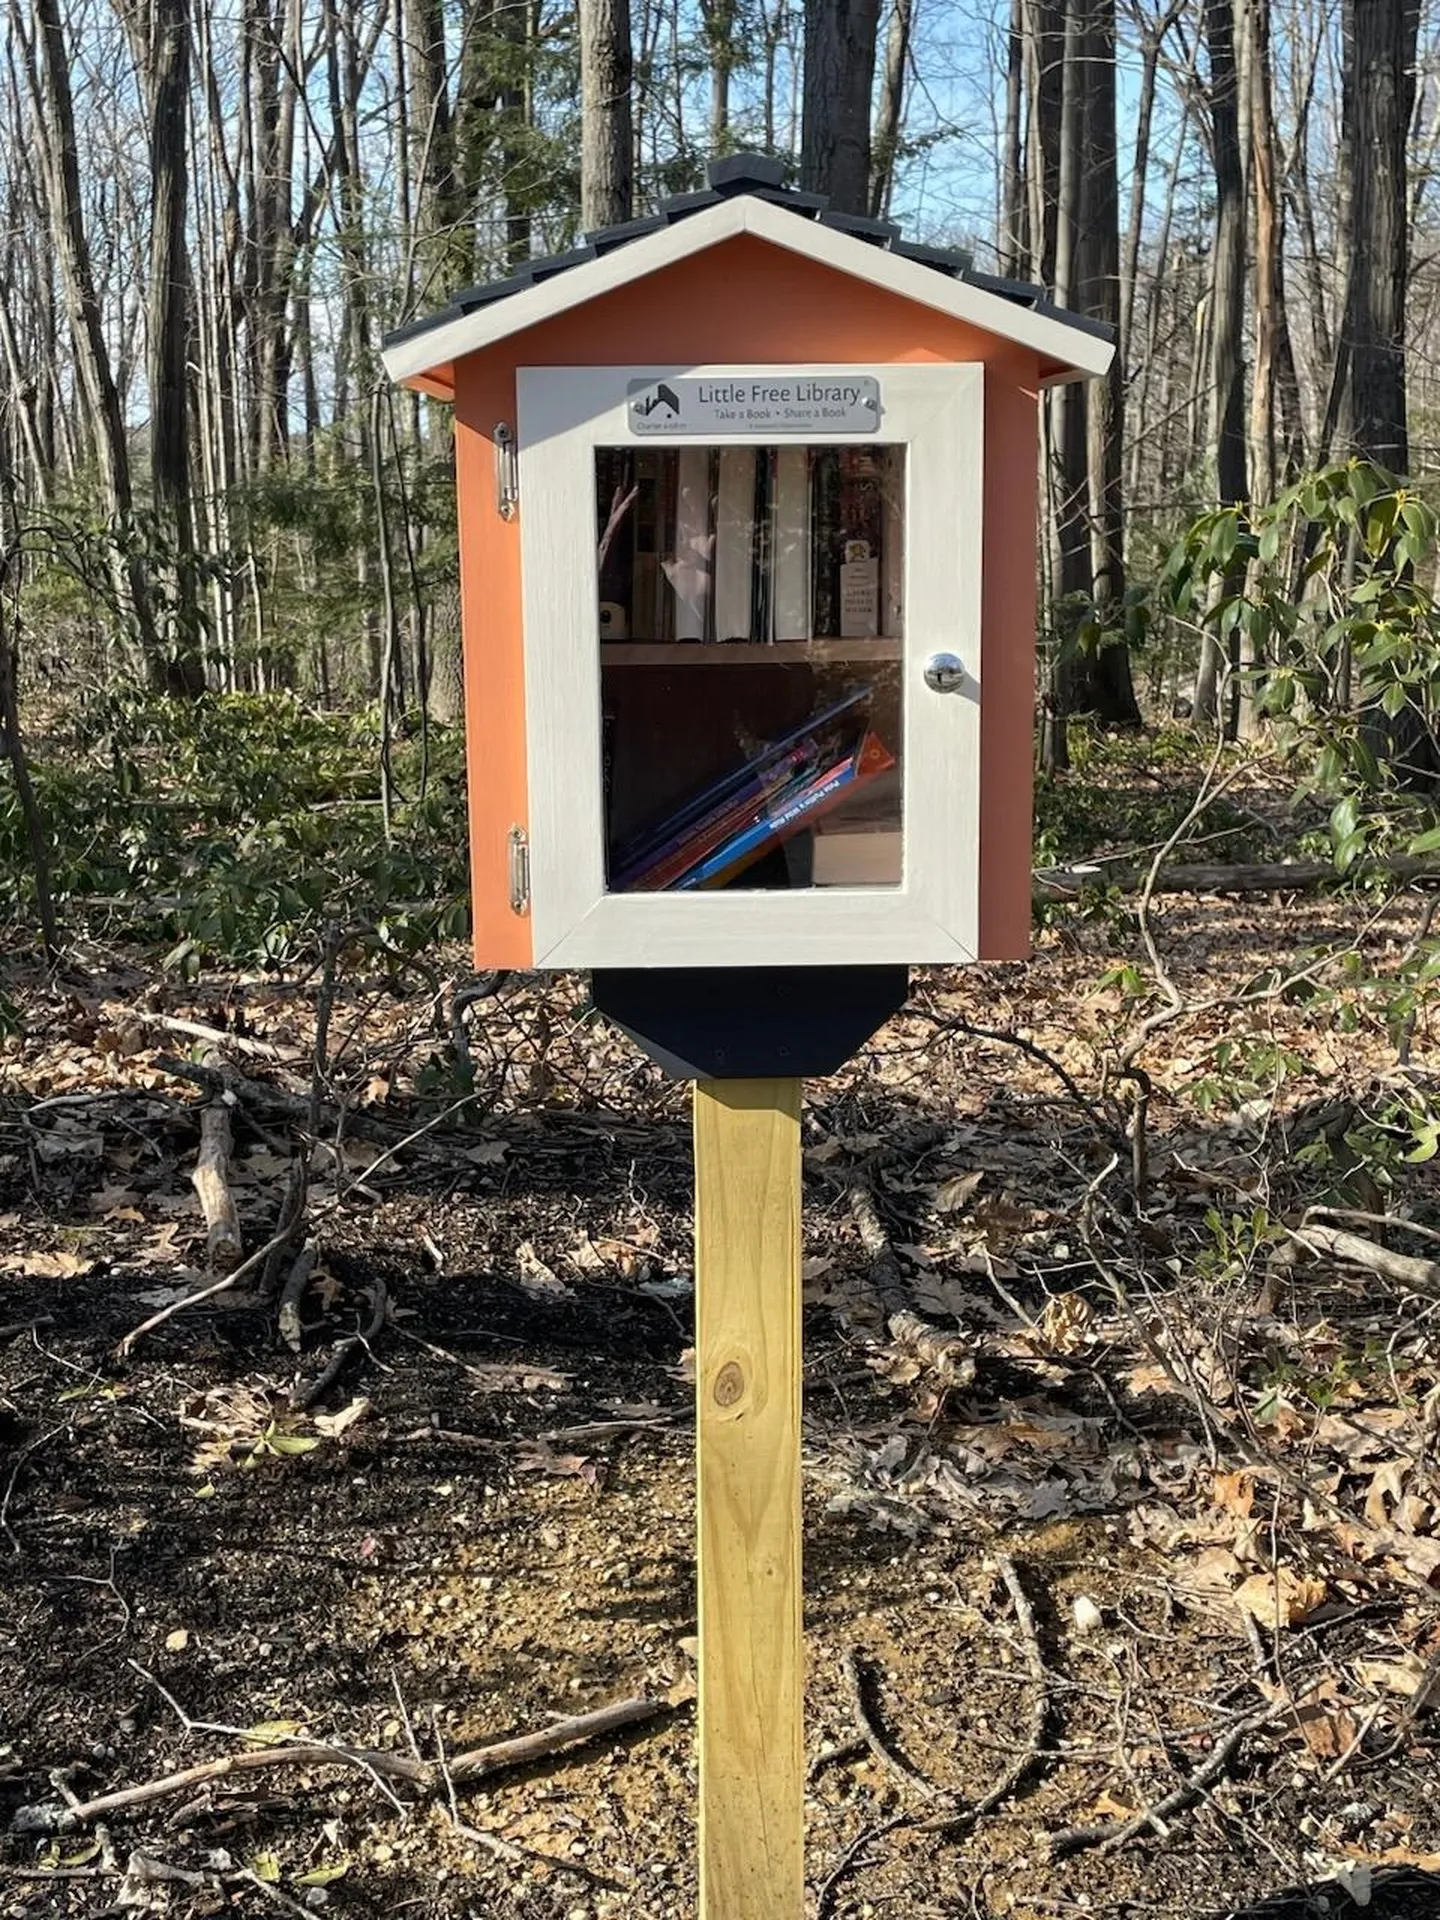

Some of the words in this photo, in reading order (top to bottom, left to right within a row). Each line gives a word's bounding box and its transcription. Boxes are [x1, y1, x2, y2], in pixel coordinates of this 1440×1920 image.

[698, 384, 745, 403] Little
[751, 385, 790, 402] Free
[797, 382, 860, 406] Library
[715, 408, 738, 419] Take
[747, 408, 771, 419] Book
[784, 407, 811, 418] Share
[813, 410, 820, 418] a
[822, 407, 846, 418] Book
